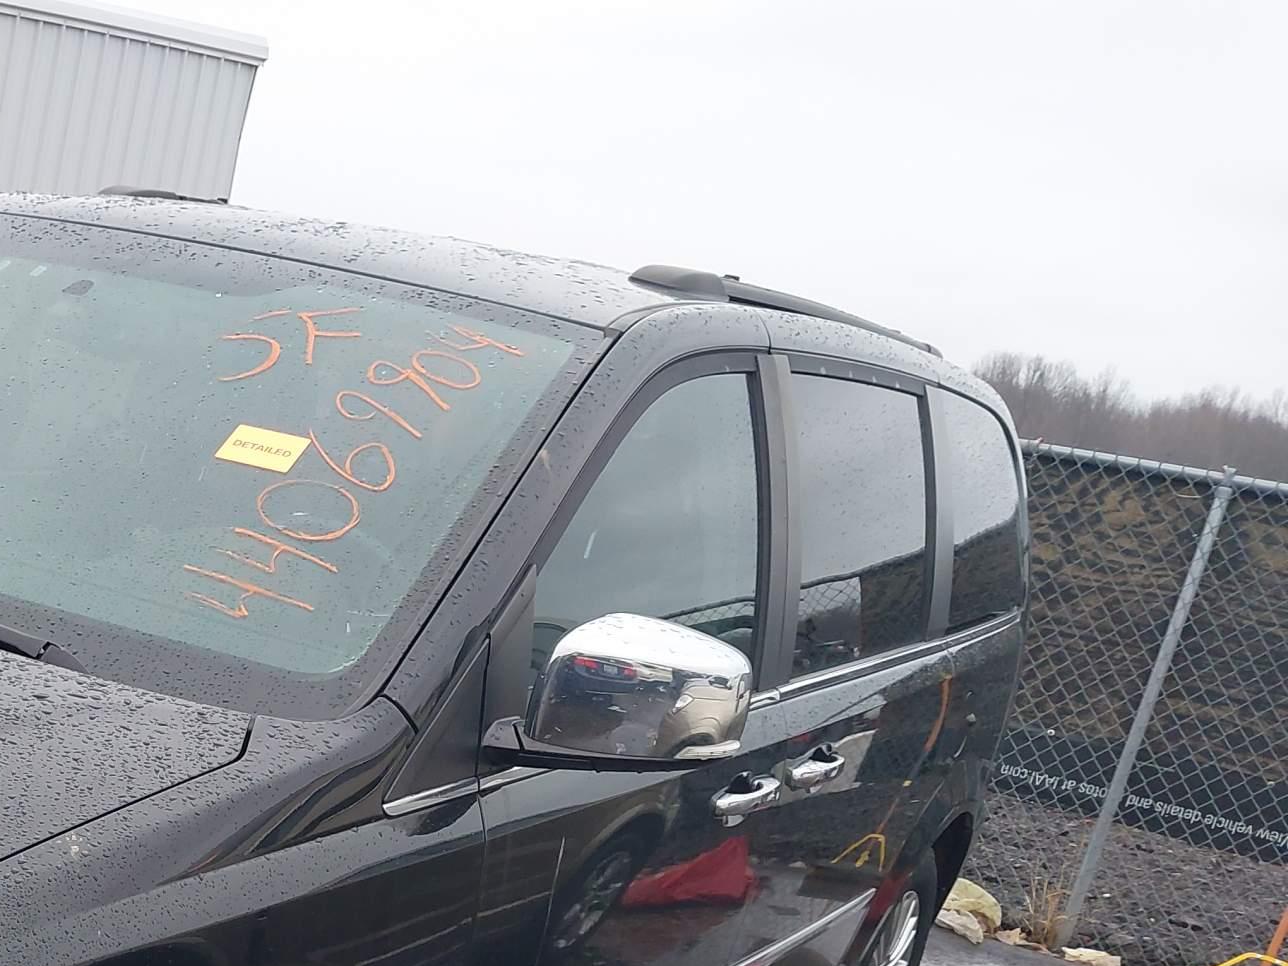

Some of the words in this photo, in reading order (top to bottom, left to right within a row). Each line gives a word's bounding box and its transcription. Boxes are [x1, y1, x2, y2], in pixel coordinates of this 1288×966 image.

[232, 439, 293, 458] DETAILED
[183, 323, 525, 618] 44069904
[1000, 763, 1060, 790] IAAI.com
[1061, 777, 1077, 790] at
[1124, 794, 1153, 808] and
[1154, 801, 1202, 824] details
[1204, 813, 1253, 835] vehicle
